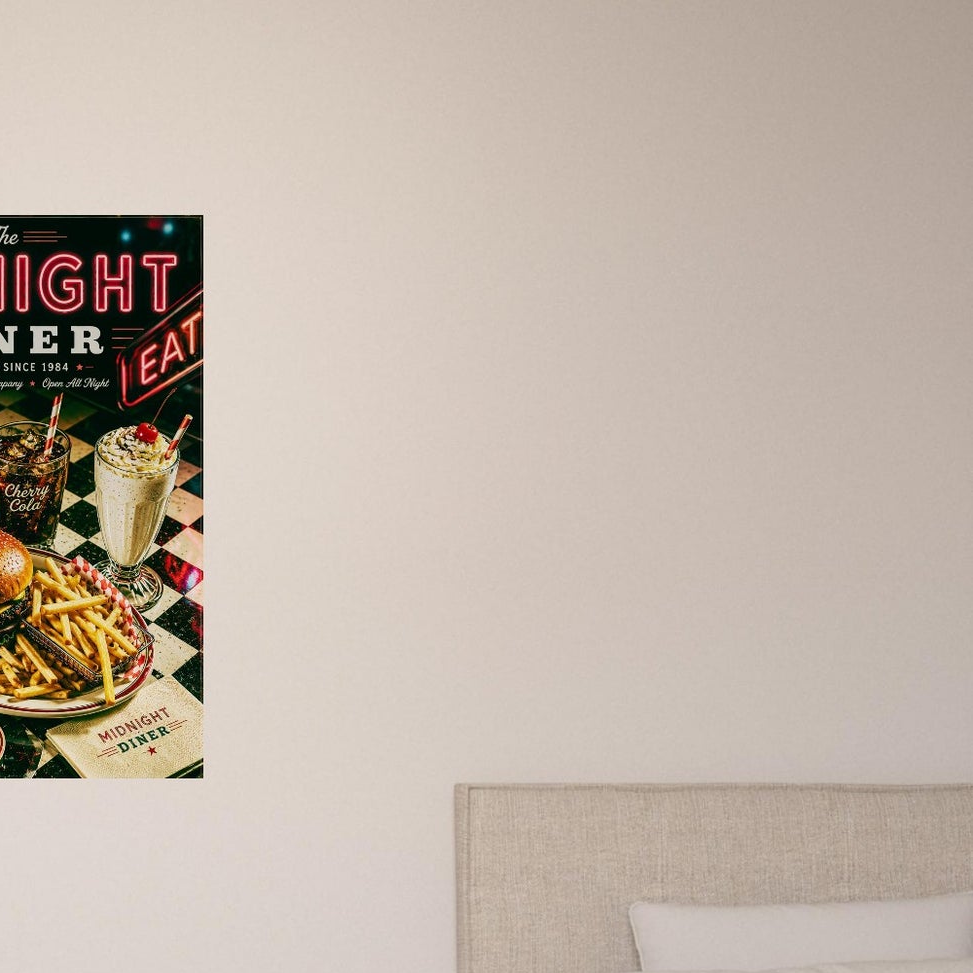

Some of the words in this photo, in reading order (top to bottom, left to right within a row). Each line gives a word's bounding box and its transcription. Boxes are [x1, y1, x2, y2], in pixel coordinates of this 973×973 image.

[139, 309, 203, 387] EAT
[3, 362, 36, 372] SINCE
[41, 362, 69, 372] 1984
[42, 377, 64, 391] Open
[65, 377, 82, 388] All
[83, 377, 110, 390] Night
[4, 483, 50, 500] Cherry
[9, 498, 42, 512] Cola
[97, 706, 172, 744] MIDNIGHT
[116, 725, 171, 754] DINER
